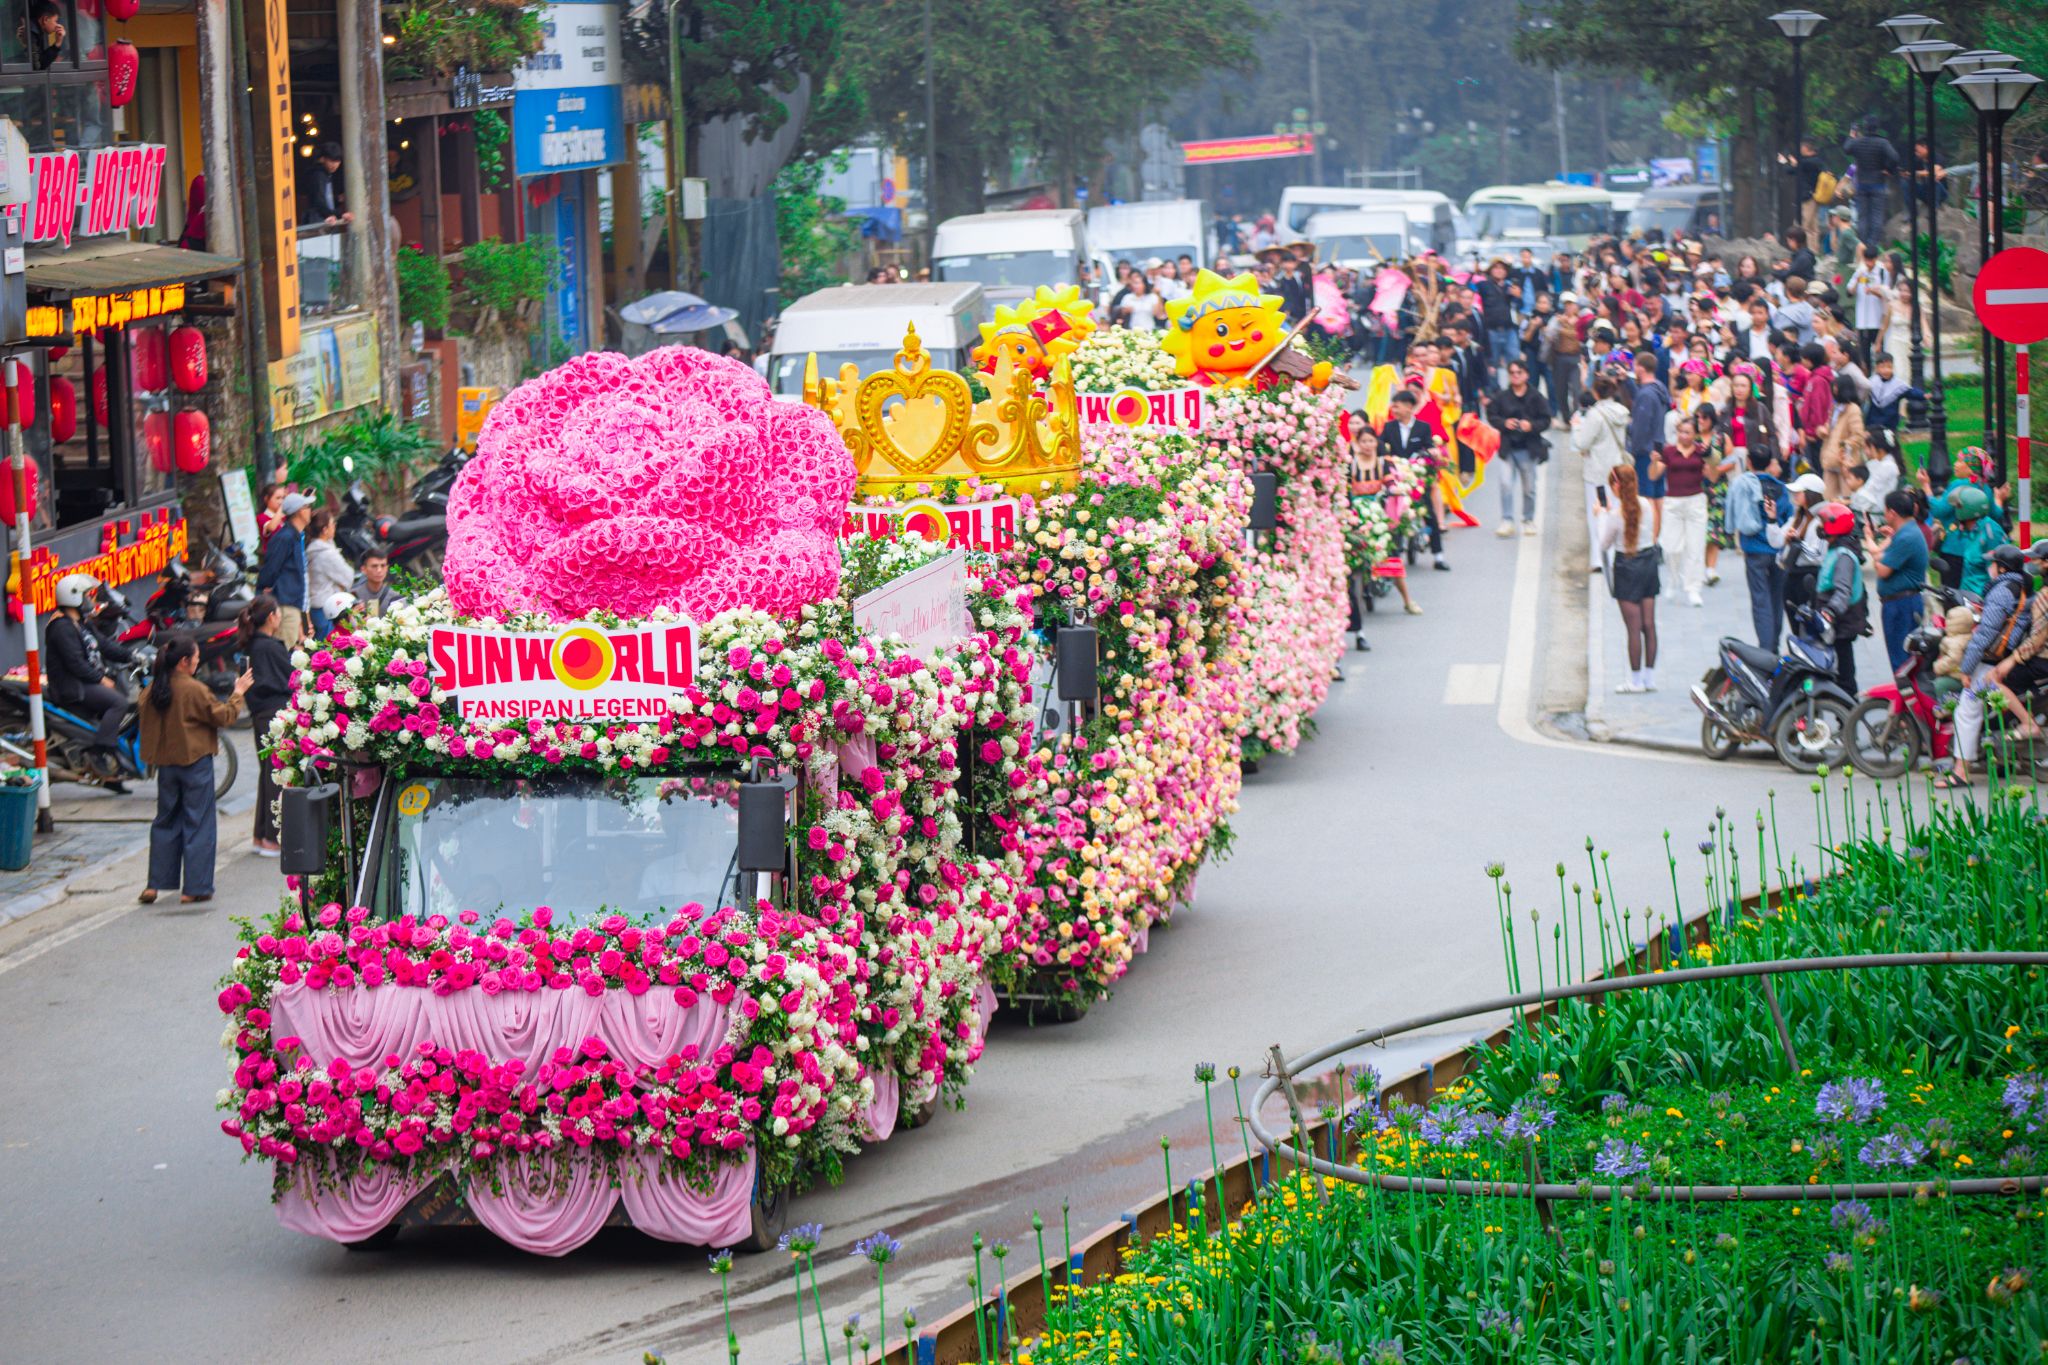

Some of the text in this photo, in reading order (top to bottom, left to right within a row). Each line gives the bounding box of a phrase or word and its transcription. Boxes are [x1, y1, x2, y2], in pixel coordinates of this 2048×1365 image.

[34, 153, 79, 246] BBQ
[88, 146, 166, 236] HOTPOT
[463, 697, 667, 719] FANSIPAN LEGEND
[403, 790, 426, 809] 02
